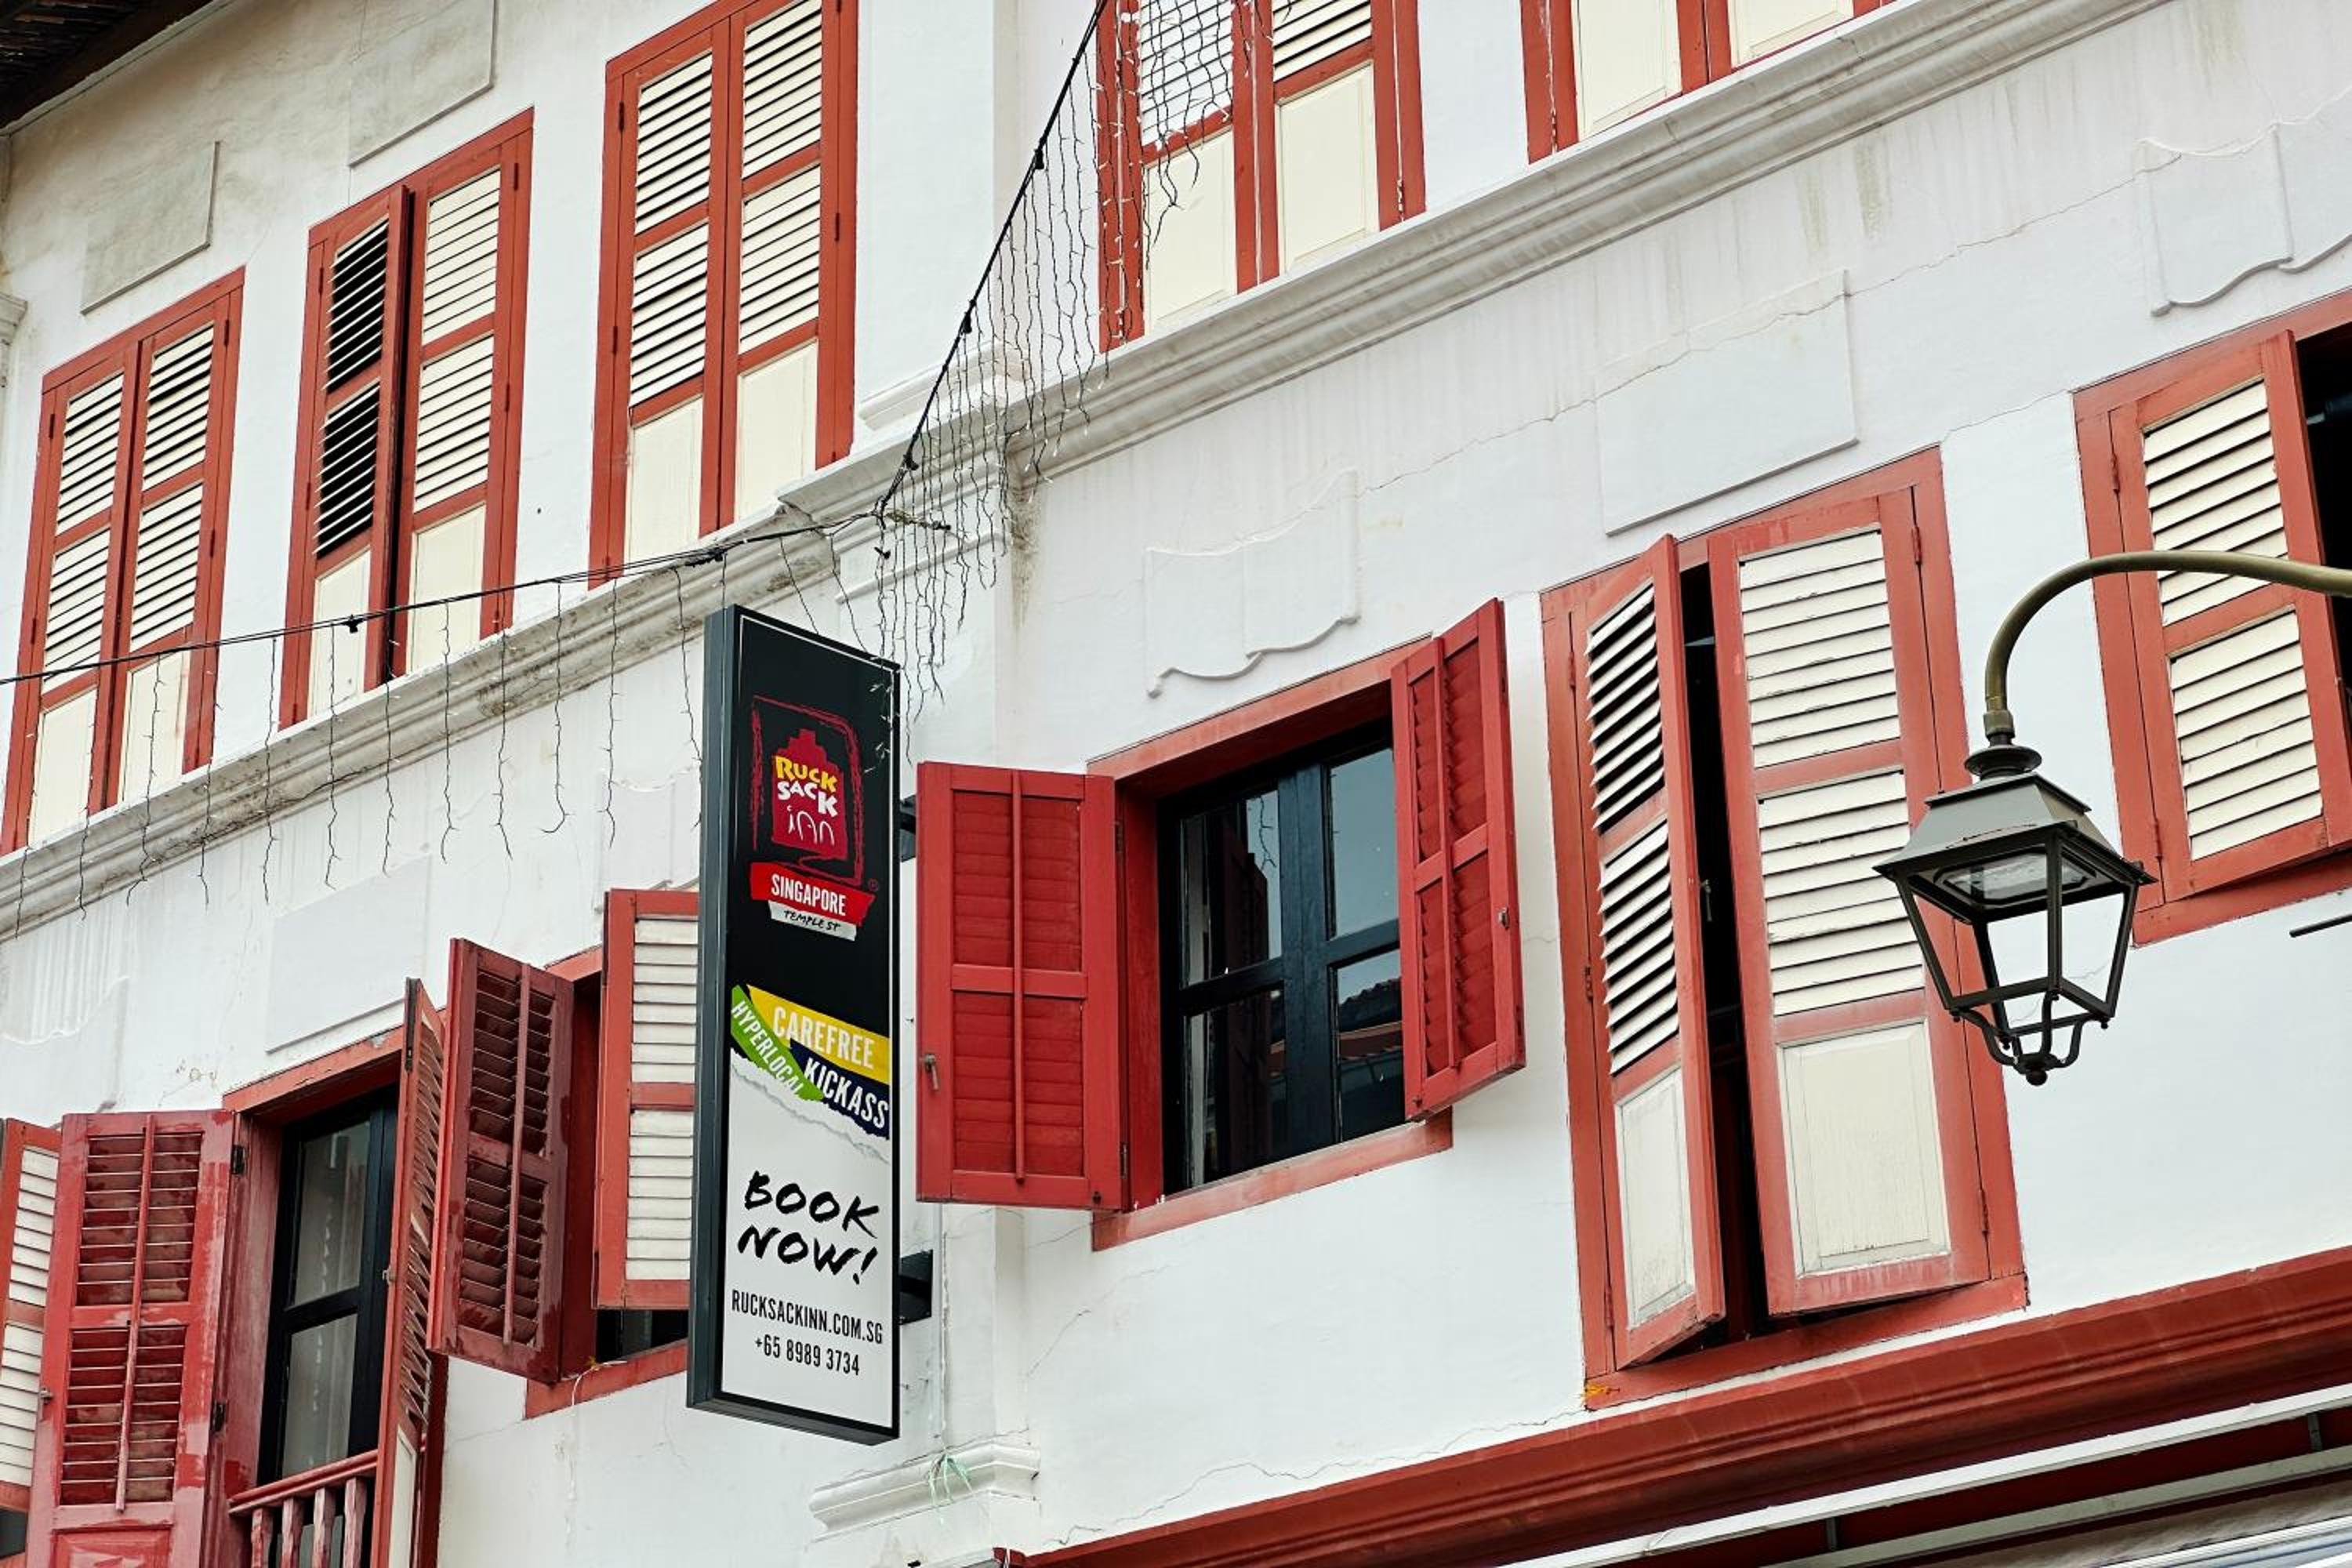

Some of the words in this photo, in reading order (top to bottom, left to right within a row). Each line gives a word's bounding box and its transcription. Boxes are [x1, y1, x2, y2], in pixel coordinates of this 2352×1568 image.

[775, 755, 838, 793] RUCK
[777, 781, 838, 817] SACK
[771, 873, 846, 916] SINGAPORE
[784, 910, 824, 928] TEMPLE
[826, 922, 841, 931] ST
[772, 1006, 874, 1069] CAREFREE
[804, 1058, 888, 1129] KICKASS
[744, 1171, 880, 1239] BOOK
[738, 1225, 878, 1285] NOW!
[731, 1289, 883, 1344] RUCKSACKINN.COM.SG
[755, 1334, 780, 1359] +65
[786, 1340, 821, 1367] 8989
[826, 1348, 860, 1376] 3734
